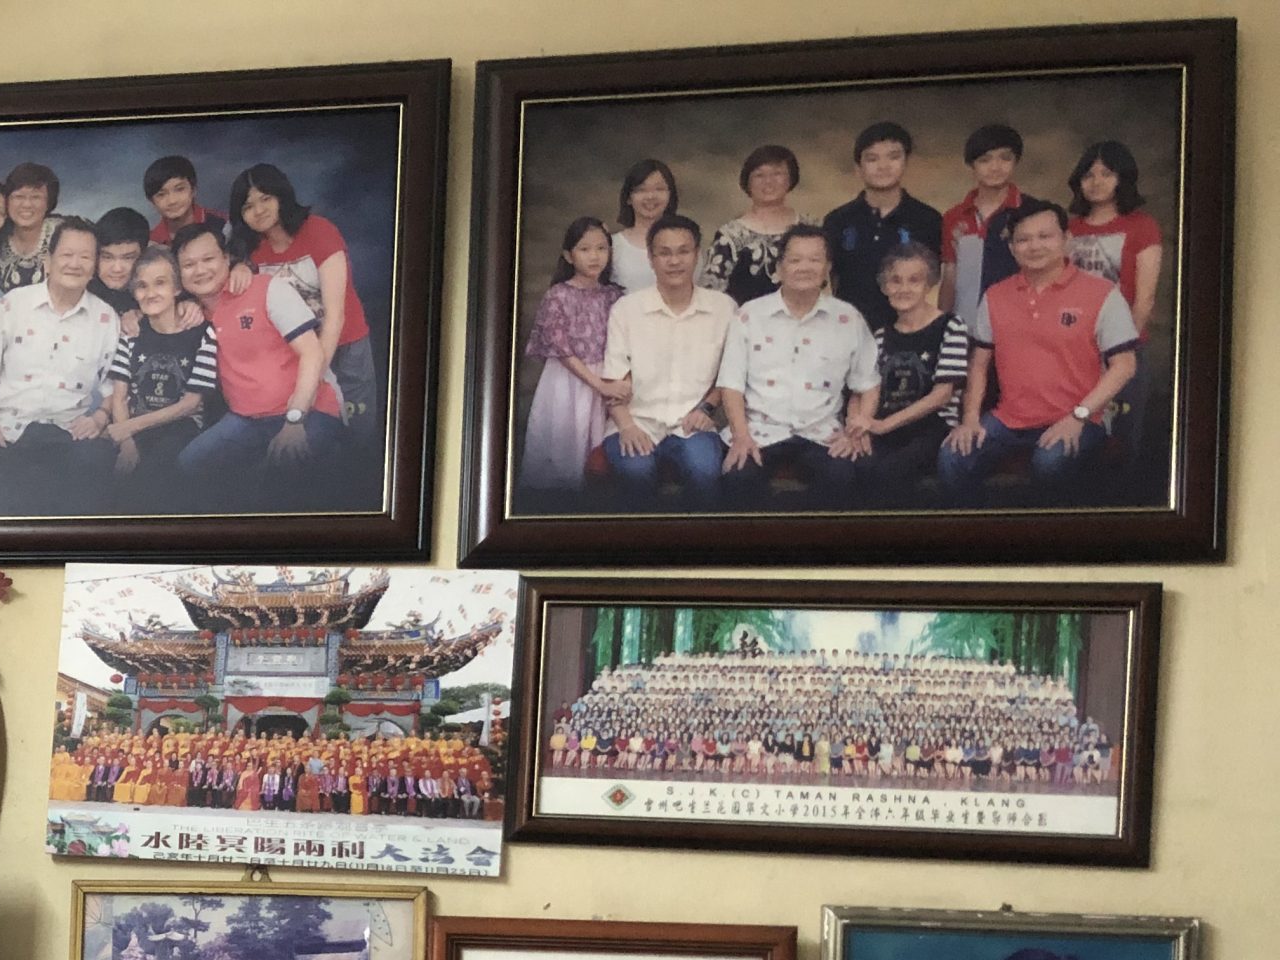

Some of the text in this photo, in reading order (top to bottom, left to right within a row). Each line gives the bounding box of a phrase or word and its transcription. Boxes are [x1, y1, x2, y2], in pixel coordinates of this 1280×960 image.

[774, 789, 837, 801] TAMAN
[960, 796, 1027, 809] KLANG
[354, 832, 408, 842] WATER
